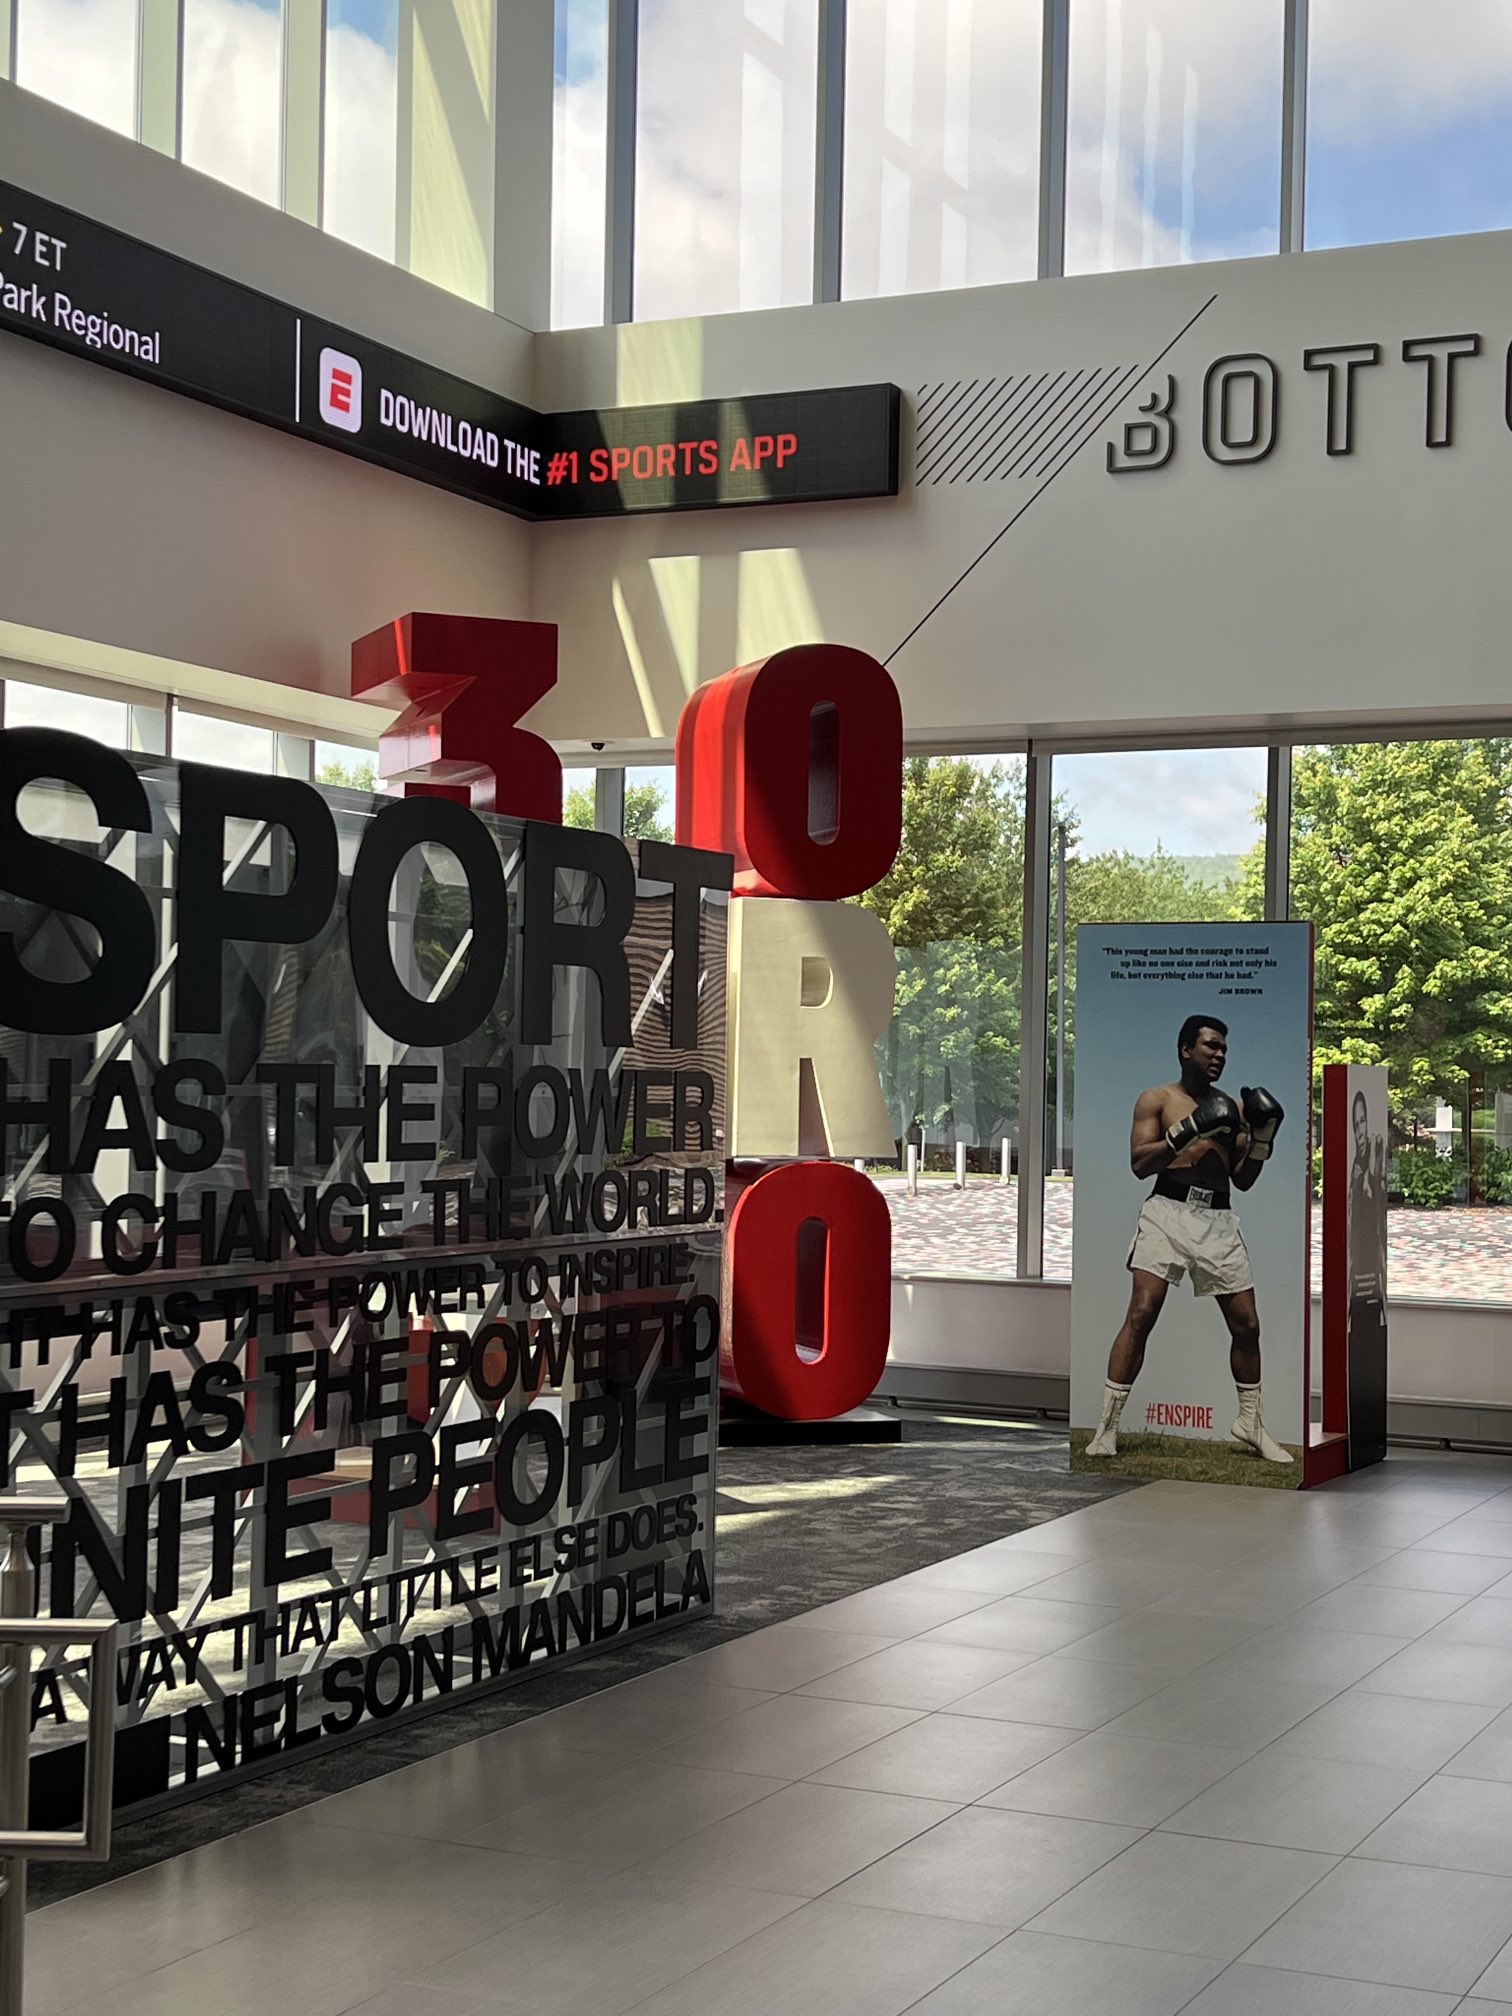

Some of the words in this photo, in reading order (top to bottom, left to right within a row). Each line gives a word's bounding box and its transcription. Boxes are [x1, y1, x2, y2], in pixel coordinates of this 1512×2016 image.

[12, 221, 28, 255] 7
[34, 231, 68, 271] ET
[54, 292, 160, 364] Regional
[380, 388, 499, 468] DOWNLOAD
[504, 439, 541, 485] THE
[546, 451, 579, 486] #1
[589, 439, 718, 484] SPORTS
[729, 434, 798, 472] APP
[1107, 333, 1512, 473] BOTT
[0, 725, 735, 1050] SPORT
[1110, 971, 1126, 979] life,
[1128, 971, 1141, 979] but
[1142, 971, 1186, 981] everything
[1187, 971, 1204, 979] else
[1205, 971, 1223, 979] that
[1224, 971, 1235, 979] he
[1120, 960, 1130, 968] up
[1132, 959, 1146, 967] like
[1176, 959, 1193, 967] else
[1194, 959, 1210, 967] and
[1211, 959, 1228, 967] risk
[1244, 959, 1263, 968] only
[1264, 959, 1278, 967] his
[1125, 948, 1148, 957] young
[1168, 947, 1184, 955] had
[1185, 947, 1199, 955] the
[1200, 947, 1233, 956] courage
[1235, 947, 1244, 955] to
[1245, 946, 1270, 955] stand
[0, 1057, 227, 1176] HAS
[256, 1063, 438, 1167] THE
[461, 1064, 715, 1160] POWER
[0, 1196, 76, 1283] O
[101, 1181, 405, 1276] CHANGE
[421, 1175, 532, 1246] THE
[545, 1167, 724, 1235] WORLD.
[80, 1291, 201, 1359] HAS
[213, 1280, 315, 1342] THE
[329, 1263, 486, 1328] POWER
[495, 1255, 549, 1306] TO
[558, 1242, 695, 1298] INSPIRE.
[58, 1361, 245, 1477] HAS
[265, 1338, 409, 1438] THE
[428, 1305, 642, 1408] POWER
[647, 1294, 721, 1368] TO
[1145, 1403, 1214, 1429] #ENSPIRE
[28, 1449, 336, 1623] NITE
[369, 1376, 711, 1559] PEOPLE
[222, 1586, 350, 1672] THAT
[362, 1546, 499, 1633] LITTLE
[509, 1519, 600, 1588] ELSE
[606, 1493, 704, 1559] DOES.
[184, 1625, 454, 1785] NELSON
[471, 1548, 711, 1685] MANDELA
